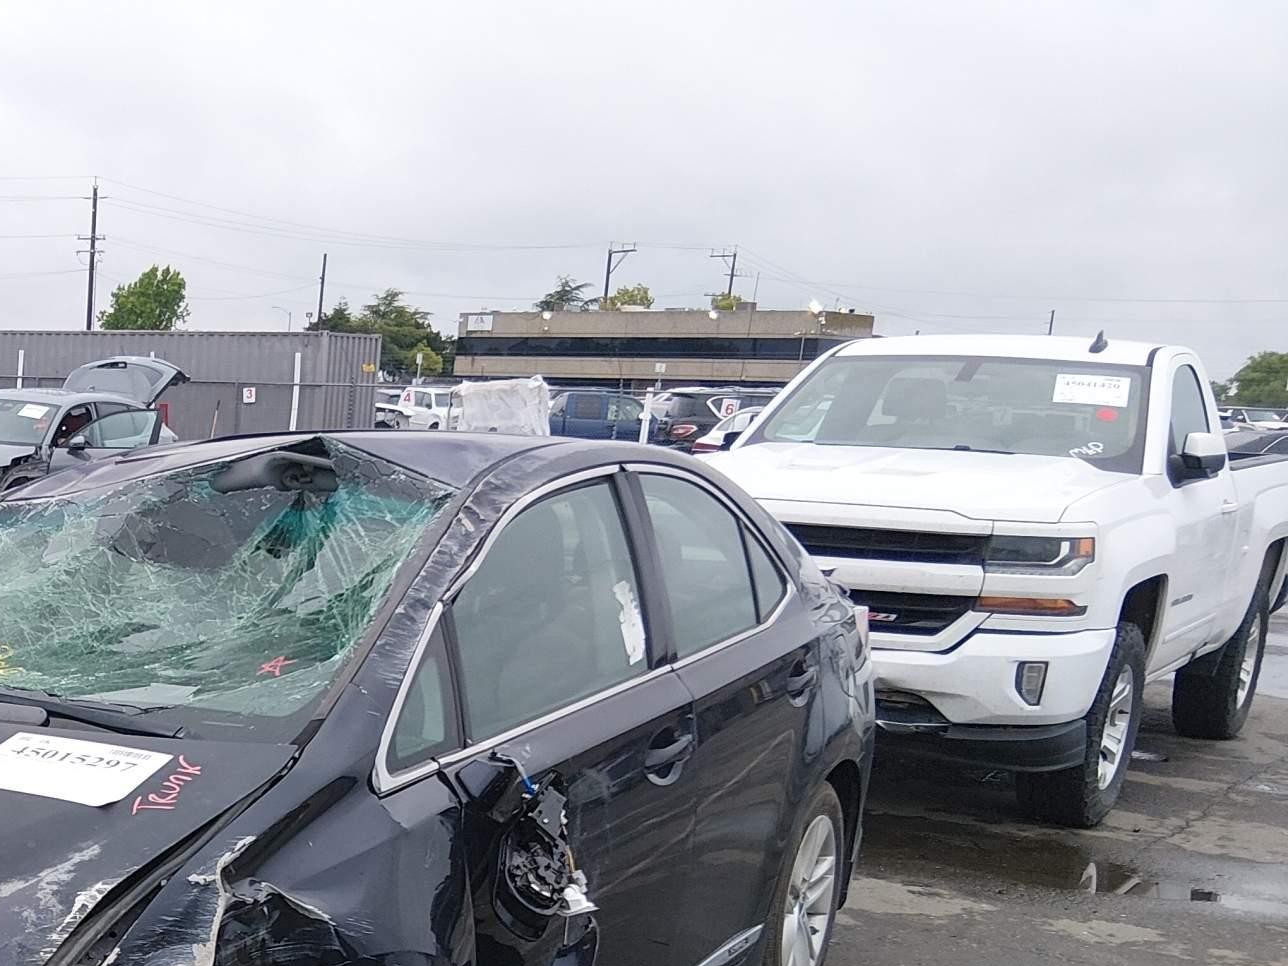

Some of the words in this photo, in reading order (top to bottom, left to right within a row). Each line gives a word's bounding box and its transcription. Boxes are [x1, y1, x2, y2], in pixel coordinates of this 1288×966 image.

[246, 388, 254, 400] 3
[403, 391, 412, 402] 4
[725, 403, 735, 416] 6
[11, 746, 139, 773] 45015297
